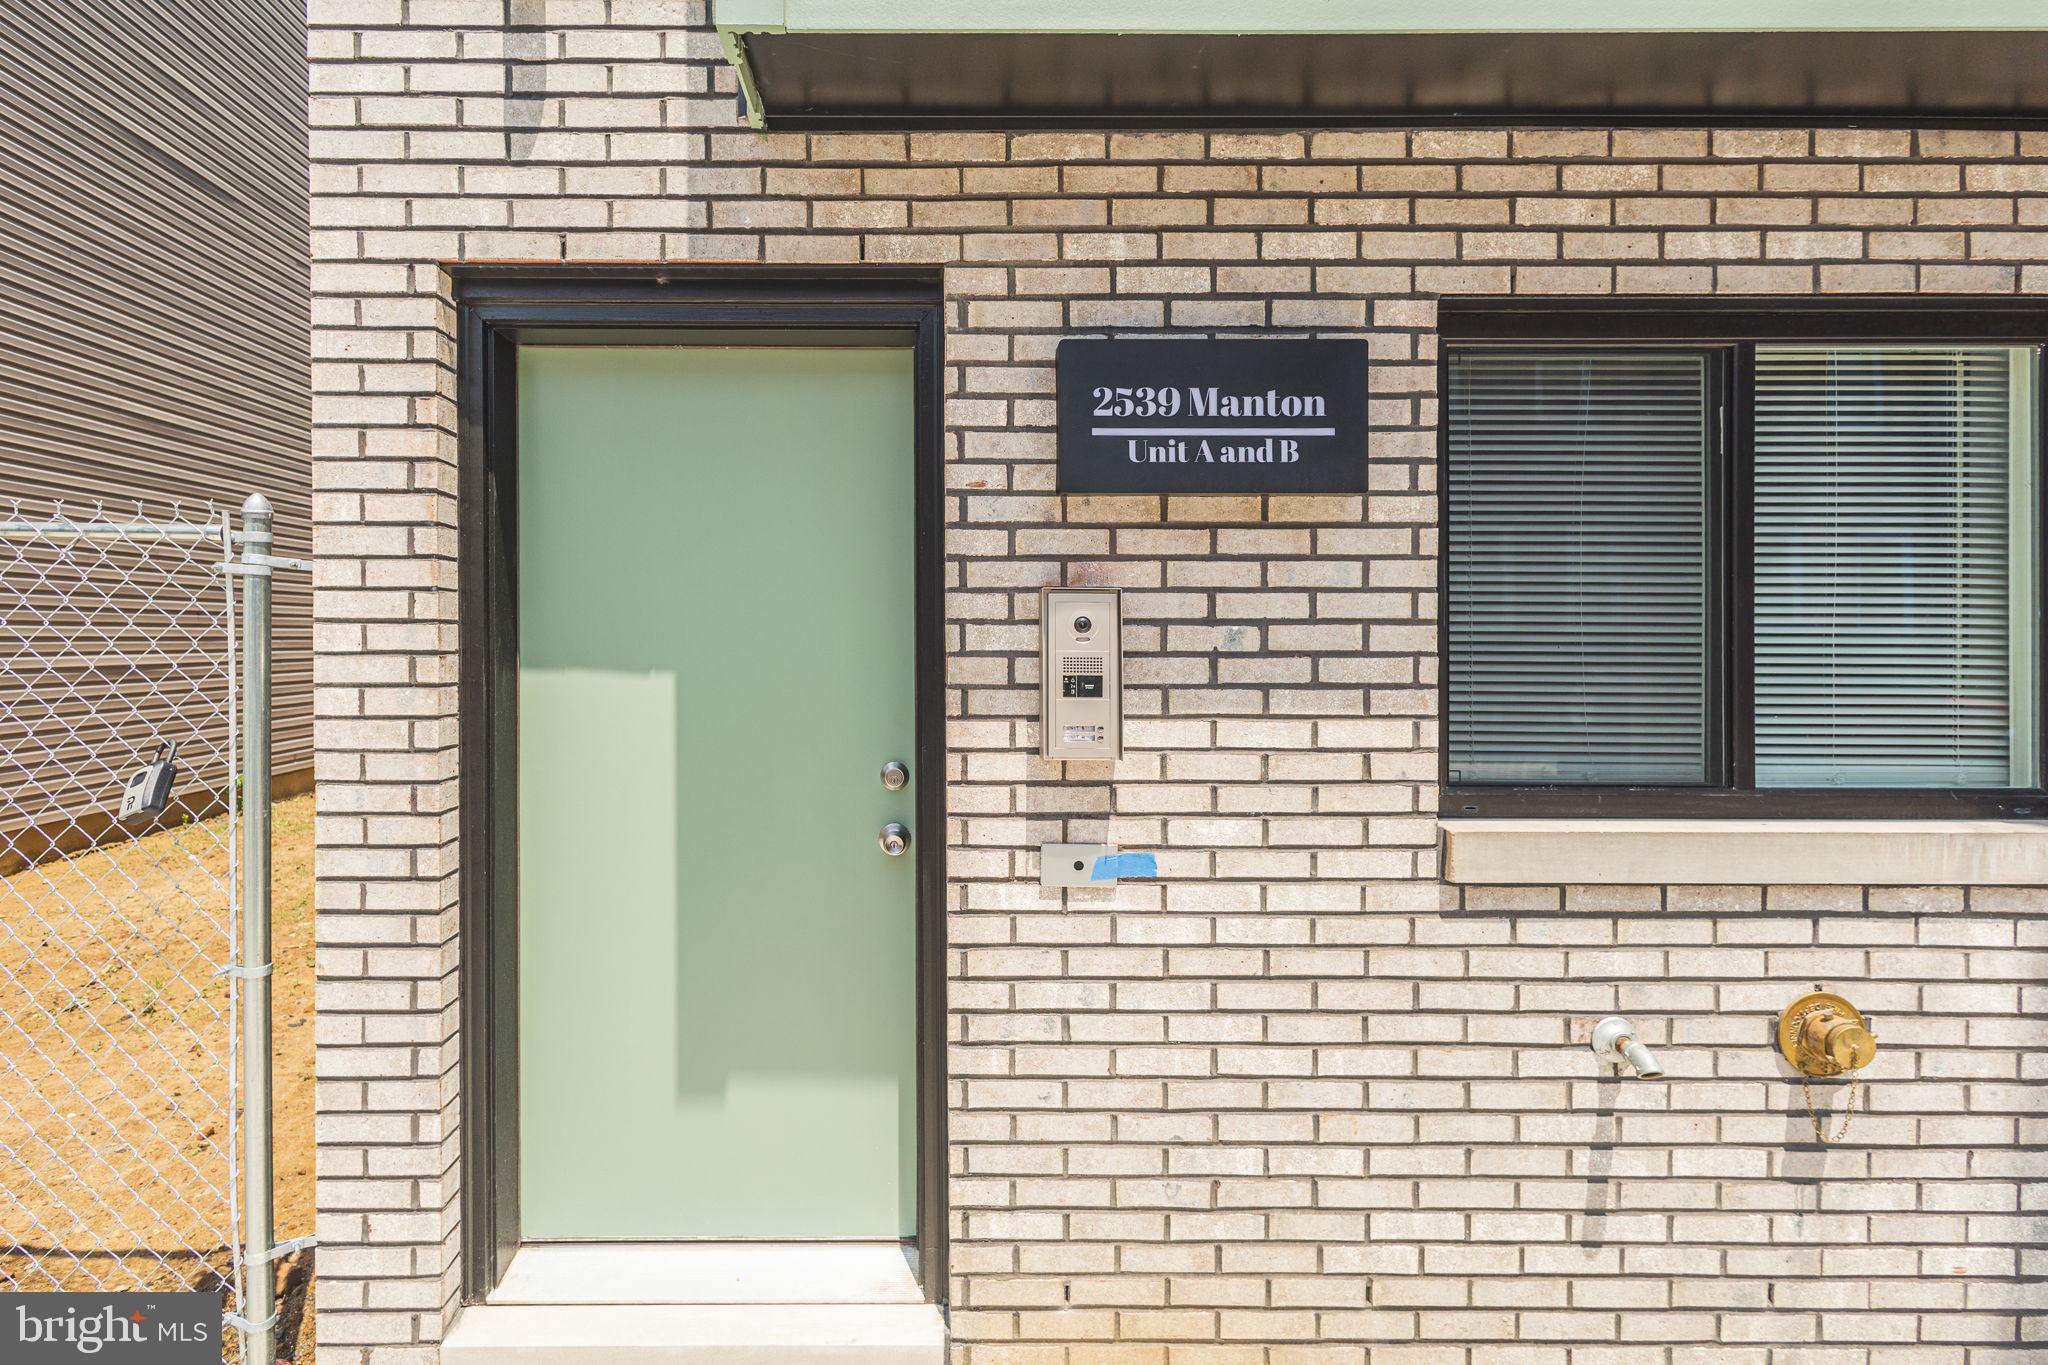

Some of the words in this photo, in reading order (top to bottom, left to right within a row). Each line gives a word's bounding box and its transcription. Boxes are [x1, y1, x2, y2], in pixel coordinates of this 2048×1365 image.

[1093, 387, 1180, 416] 2539
[1188, 388, 1326, 416] Manton
[1128, 439, 1189, 462] Unit
[1195, 440, 1214, 462] A
[1220, 439, 1273, 462] and
[1280, 440, 1299, 462] B
